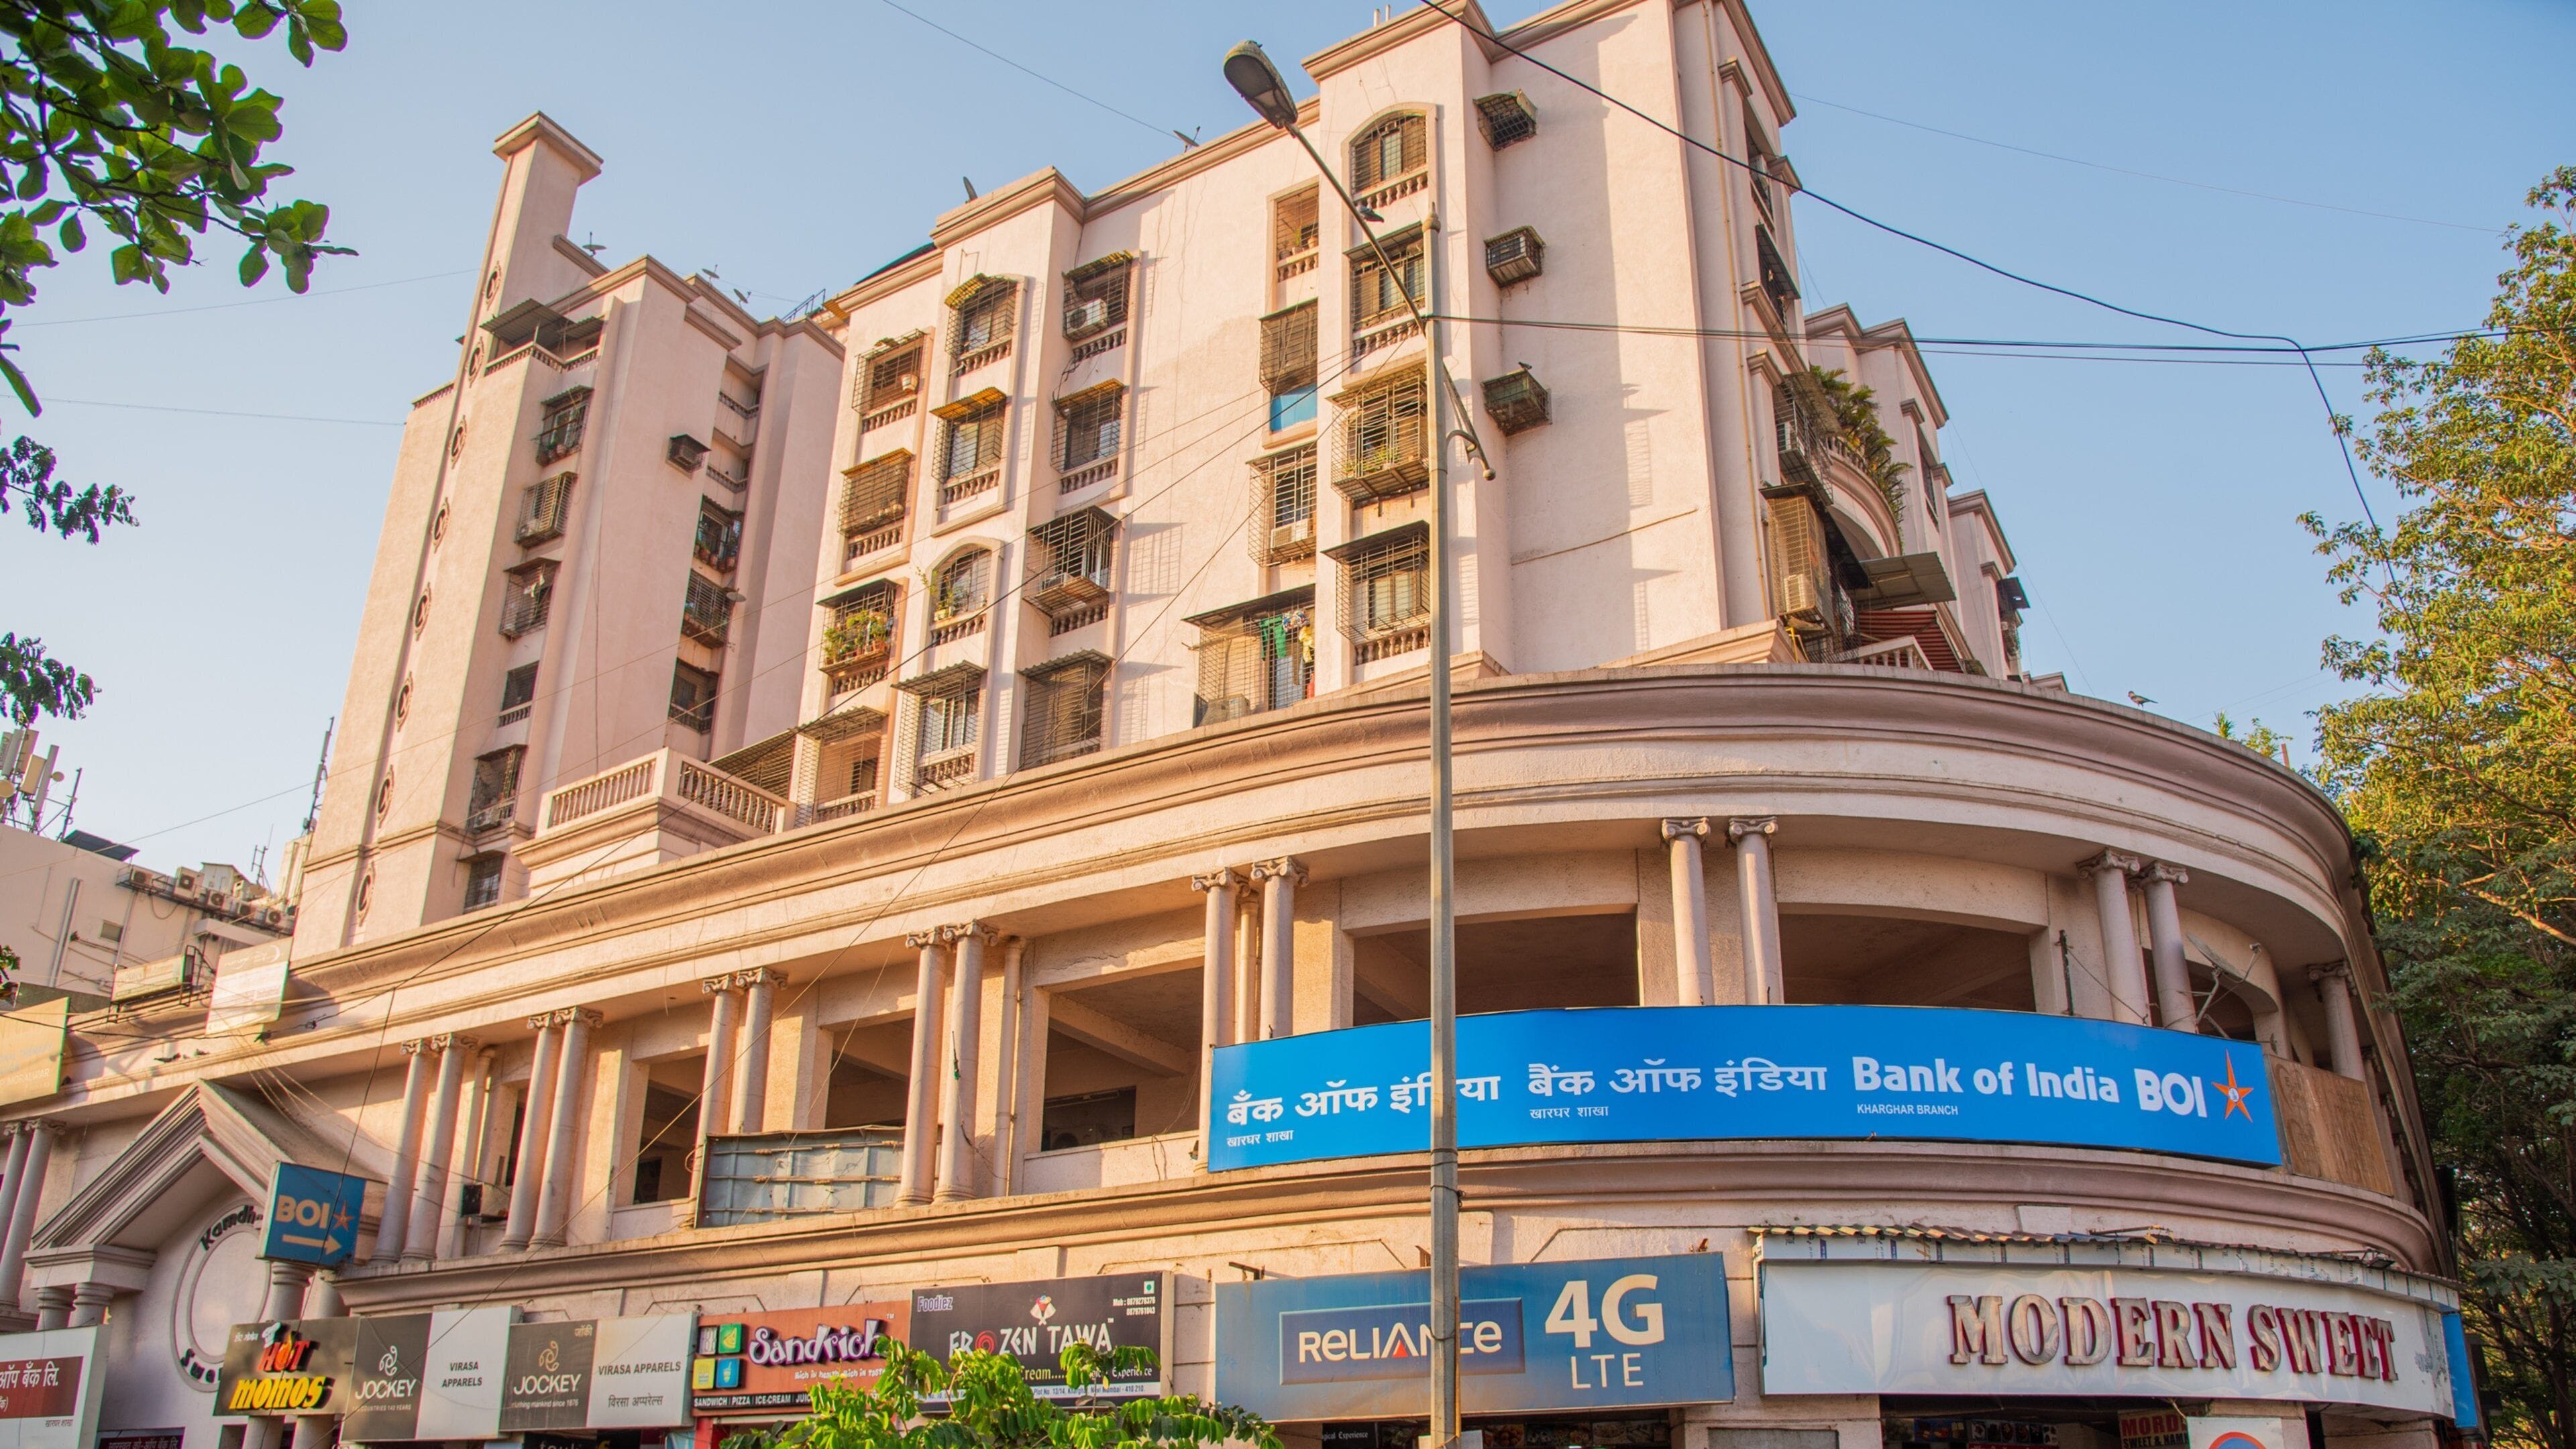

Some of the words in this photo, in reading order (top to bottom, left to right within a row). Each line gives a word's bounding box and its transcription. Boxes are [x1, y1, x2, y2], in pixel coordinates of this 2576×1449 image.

[1528, 1063, 1595, 1097] बैंक
[1609, 1058, 1702, 1094] ऑफ
[1715, 1056, 1827, 1098] इंडिया
[1851, 1056, 1964, 1093] Bank
[1973, 1061, 2012, 1095] of
[2025, 1063, 2120, 1103] India
[2134, 1068, 2208, 1118] BOI
[1227, 1089, 1284, 1125] बँक
[1295, 1079, 1378, 1116] ऑफ
[1390, 1071, 1501, 1114] इंिया
[1857, 1104, 1915, 1115] KHARGHAR
[1917, 1105, 1959, 1116] BRANCH
[1529, 1107, 1570, 1120] खारघर
[1577, 1106, 1609, 1118] शाखा
[1227, 1134, 1261, 1147] खारघर
[1265, 1130, 1295, 1142] शाखा
[275, 1195, 329, 1230] BOI
[917, 1295, 953, 1313] Foodiez
[1545, 1274, 1665, 1349] 4G
[749, 1318, 884, 1366] Sandrich
[1047, 1323, 1112, 1354] TAWA
[1947, 1293, 2237, 1370] MODERN
[2250, 1303, 2399, 1382] SWEET
[258, 1332, 312, 1373] HOT
[450, 1361, 479, 1371] VIRASA
[22, 1360, 42, 1387] बँक
[598, 1364, 631, 1375] VIRASA
[633, 1361, 682, 1374] APPARELS
[1571, 1353, 1644, 1389] LTE
[356, 1379, 417, 1400] JOCKEY
[441, 1377, 482, 1388] APPARELS
[513, 1373, 582, 1395] JOCKEY
[694, 1397, 727, 1407] SANDWICH
[732, 1396, 751, 1405] PIZZA
[755, 1395, 791, 1404] ICE-CREAM
[796, 1393, 810, 1403] JUIC
